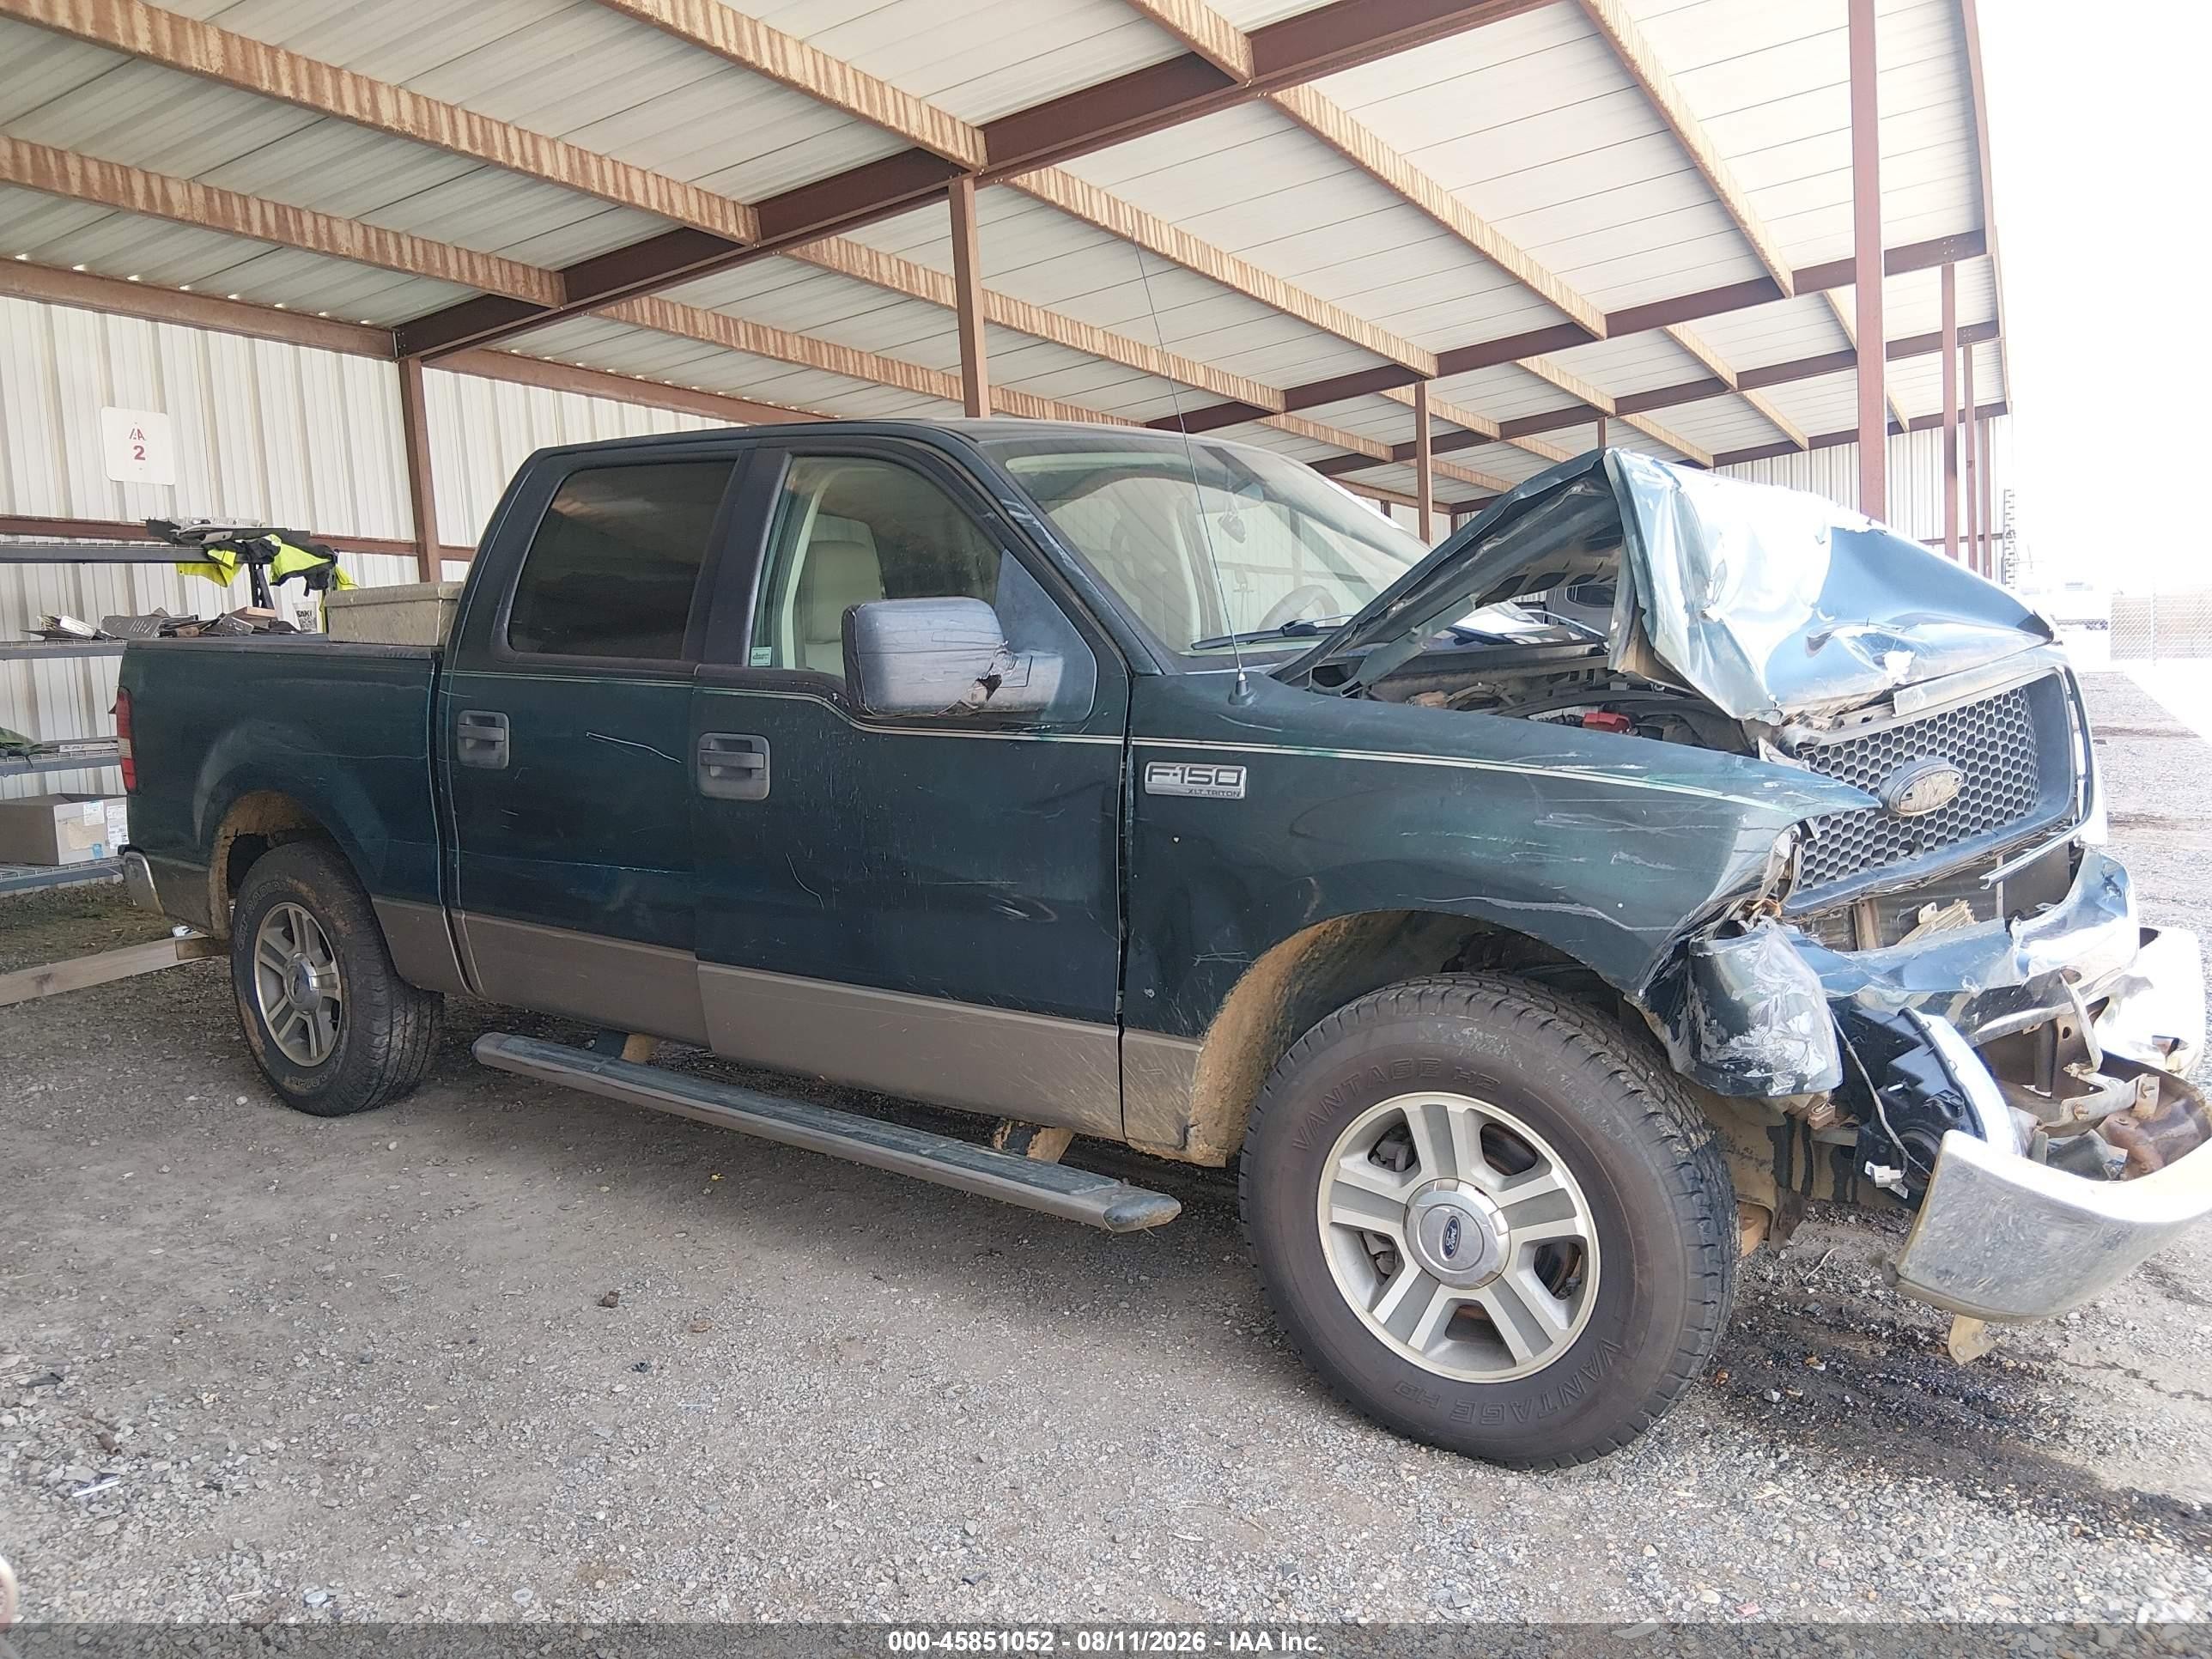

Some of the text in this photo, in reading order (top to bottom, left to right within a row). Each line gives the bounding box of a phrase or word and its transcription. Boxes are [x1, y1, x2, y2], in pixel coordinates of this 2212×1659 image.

[133, 445, 146, 460] 2
[1147, 765, 1243, 787] F-150
[1291, 1057, 1443, 1152] VANTAGE
[1449, 1338, 1623, 1426] VANTAGE
